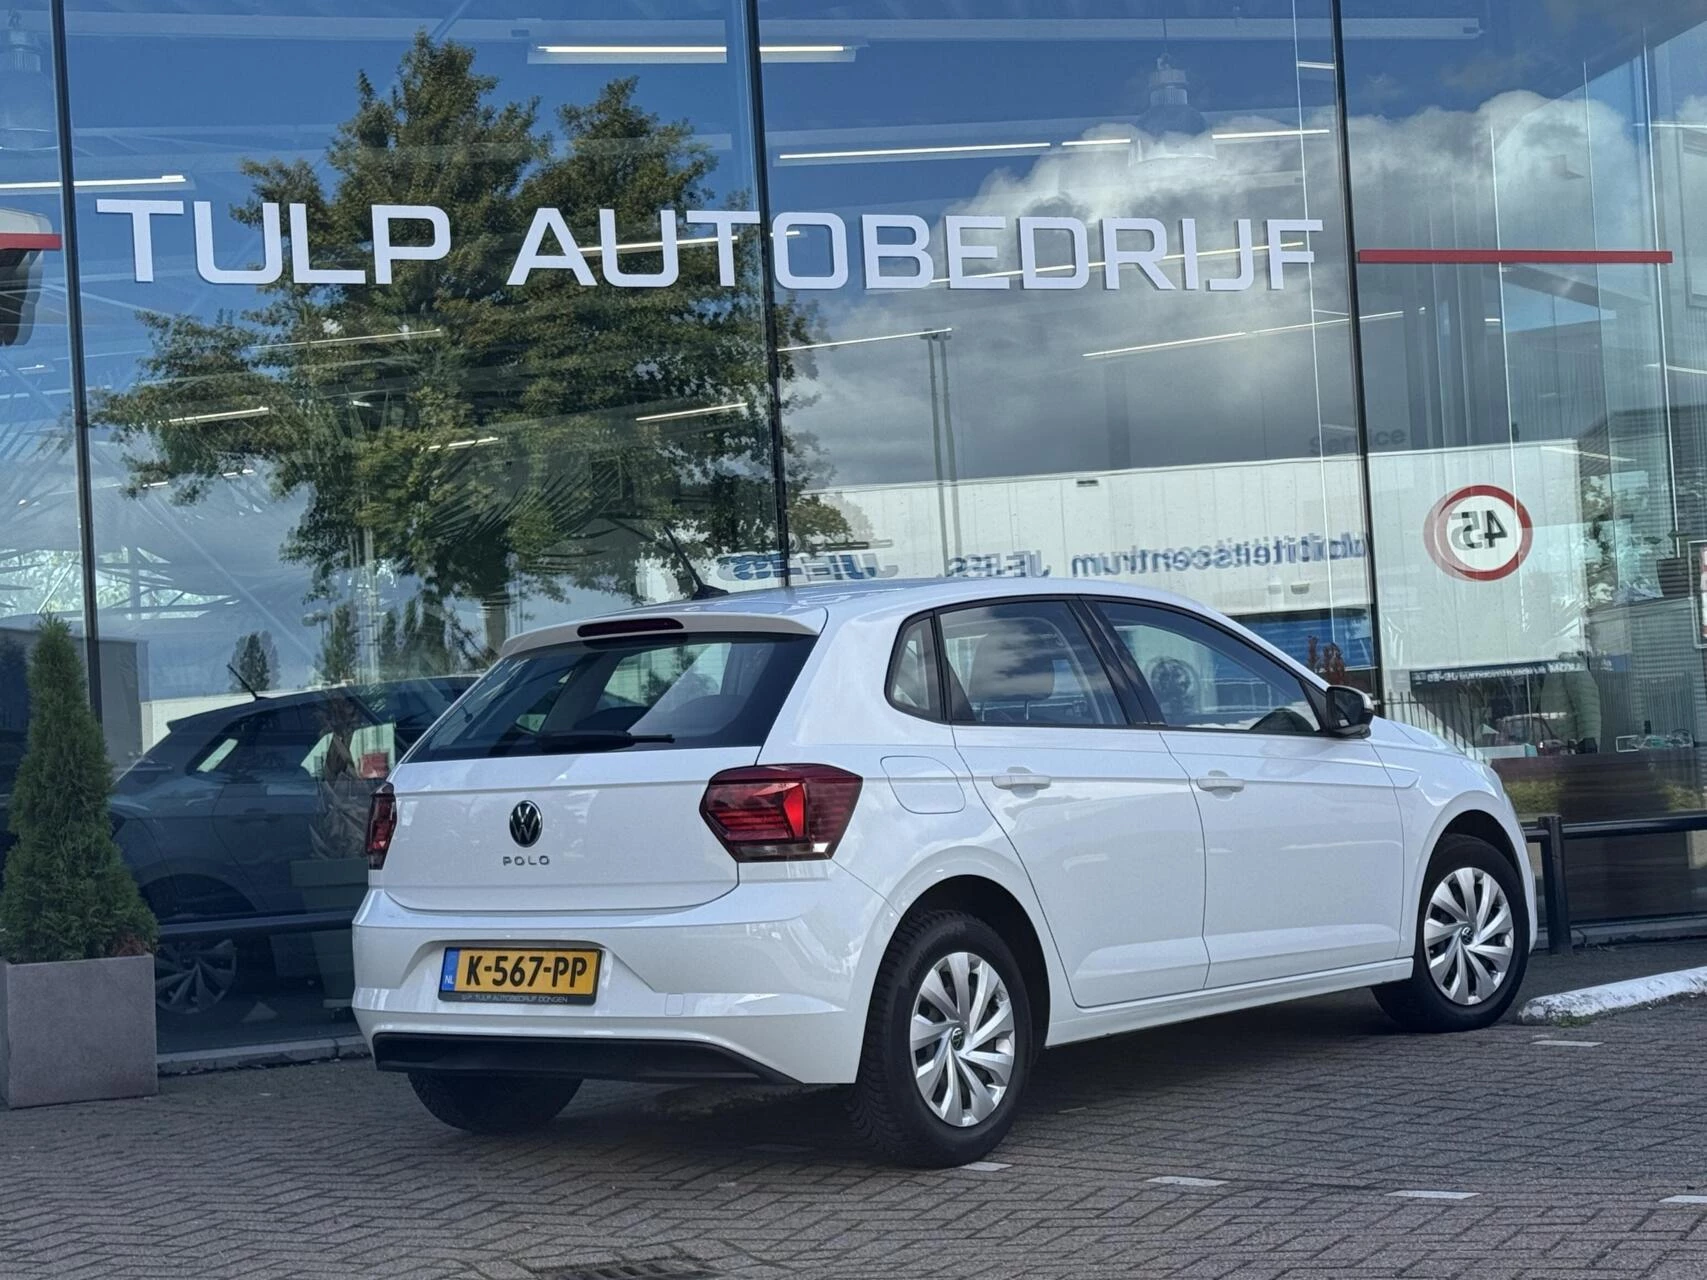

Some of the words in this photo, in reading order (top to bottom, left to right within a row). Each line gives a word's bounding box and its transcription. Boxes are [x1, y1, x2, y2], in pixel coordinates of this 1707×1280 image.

[96, 199, 451, 285] TULP
[506, 207, 1323, 291] AUTOBEDRIJF
[502, 855, 550, 867] POLO
[444, 975, 454, 985] NL
[466, 955, 588, 988] K-567-PP
